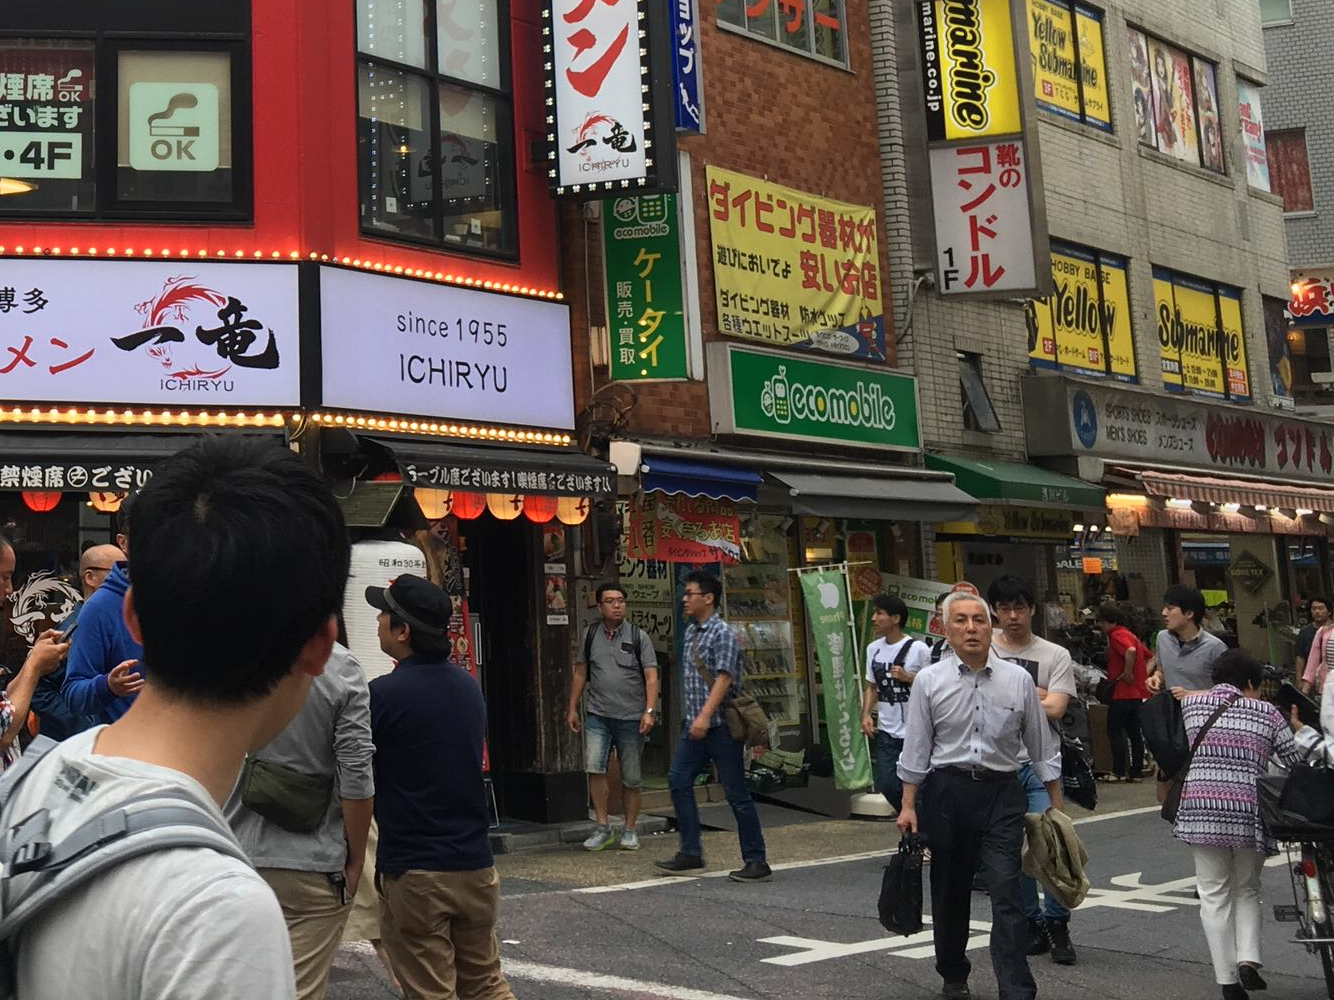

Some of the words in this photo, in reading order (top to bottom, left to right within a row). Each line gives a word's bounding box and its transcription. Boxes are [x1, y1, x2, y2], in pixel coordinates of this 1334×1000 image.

[1031, 8, 1067, 50] Yellow
[58, 91, 81, 102] OK
[150, 138, 196, 161] OK
[578, 158, 629, 173] ICHIRYU
[995, 144, 1021, 188] 靴の
[614, 223, 669, 239] ecomobile
[709, 178, 875, 254] ダイビング器材が
[956, 146, 1006, 288] コンドル
[716, 244, 791, 280] 遊びにおいでよ
[799, 250, 878, 300] 安いお店
[943, 247, 959, 290] 1F
[1051, 260, 1081, 277] HOBBY
[634, 247, 664, 367] ケータイ
[719, 288, 789, 321] ダイビング器材
[397, 310, 448, 338] since
[455, 317, 508, 348] 1955
[159, 378, 234, 392] ICHIRYU
[399, 353, 508, 394] ICHIRYU
[791, 381, 895, 430] ecomobile
[1105, 425, 1127, 442] MEN'S
[1127, 428, 1148, 445] SHOES
